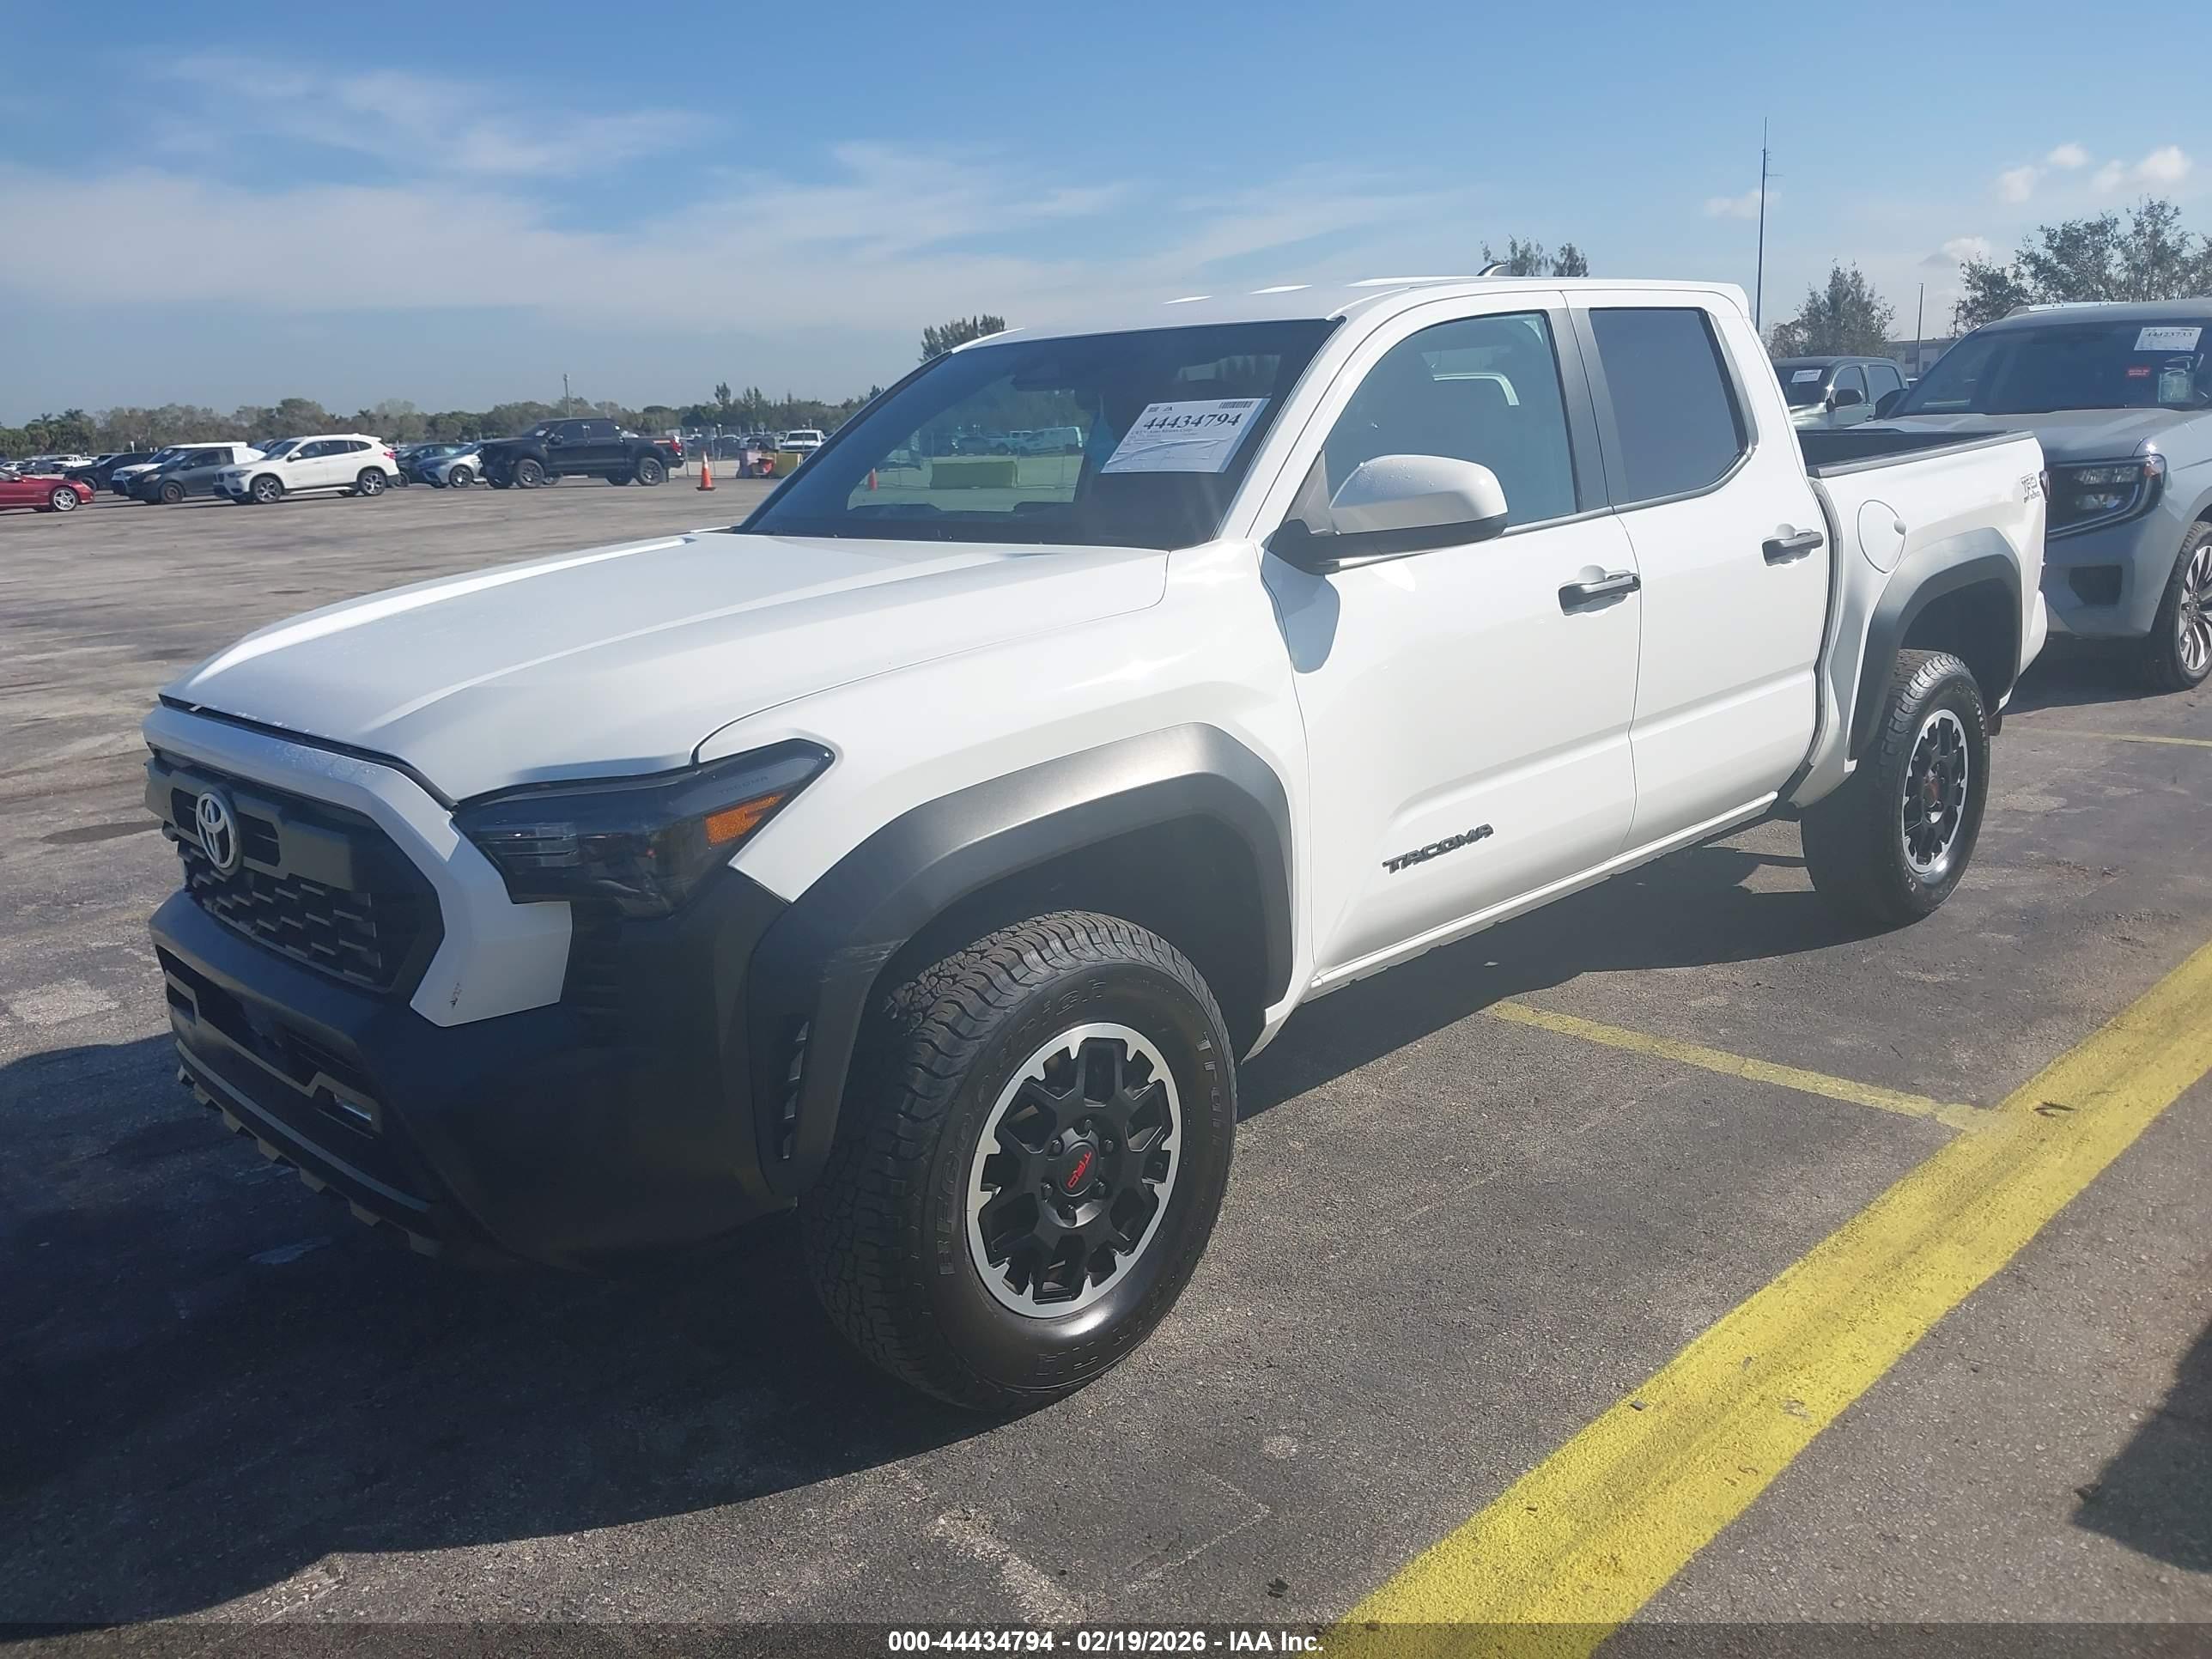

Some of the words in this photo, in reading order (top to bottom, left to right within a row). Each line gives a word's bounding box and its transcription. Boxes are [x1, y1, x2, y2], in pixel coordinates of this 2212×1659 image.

[1143, 413, 1243, 430] 44434794
[1382, 823, 1494, 874] TACOMA
[1067, 1150, 1092, 1189] TRD
